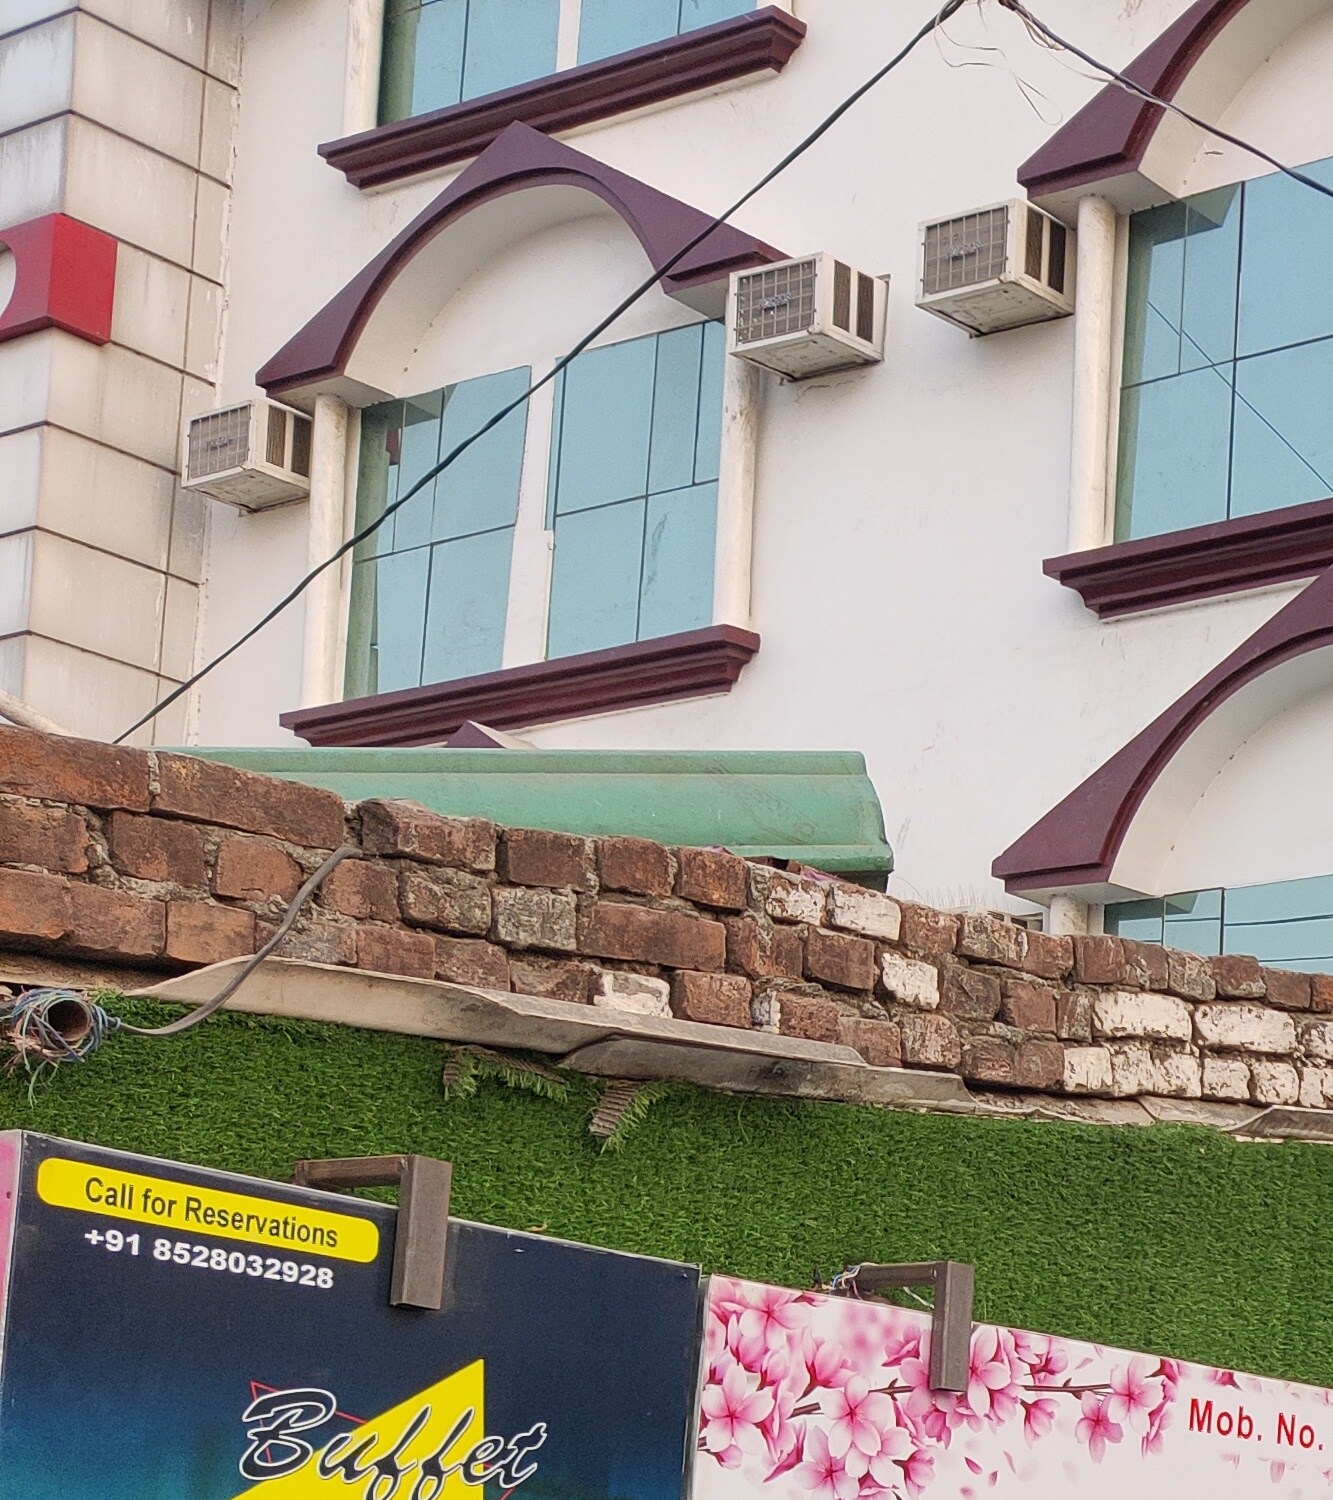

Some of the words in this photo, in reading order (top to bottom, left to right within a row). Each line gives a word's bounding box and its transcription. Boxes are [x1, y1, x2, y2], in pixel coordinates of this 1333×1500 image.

[85, 1176, 133, 1210] Call
[142, 1187, 176, 1218] for
[184, 1196, 339, 1250] Reservations
[84, 1228, 141, 1257] +91
[152, 1238, 334, 1289] 8528032928
[1188, 1398, 1264, 1442] Mob.
[1277, 1411, 1324, 1451] No.
